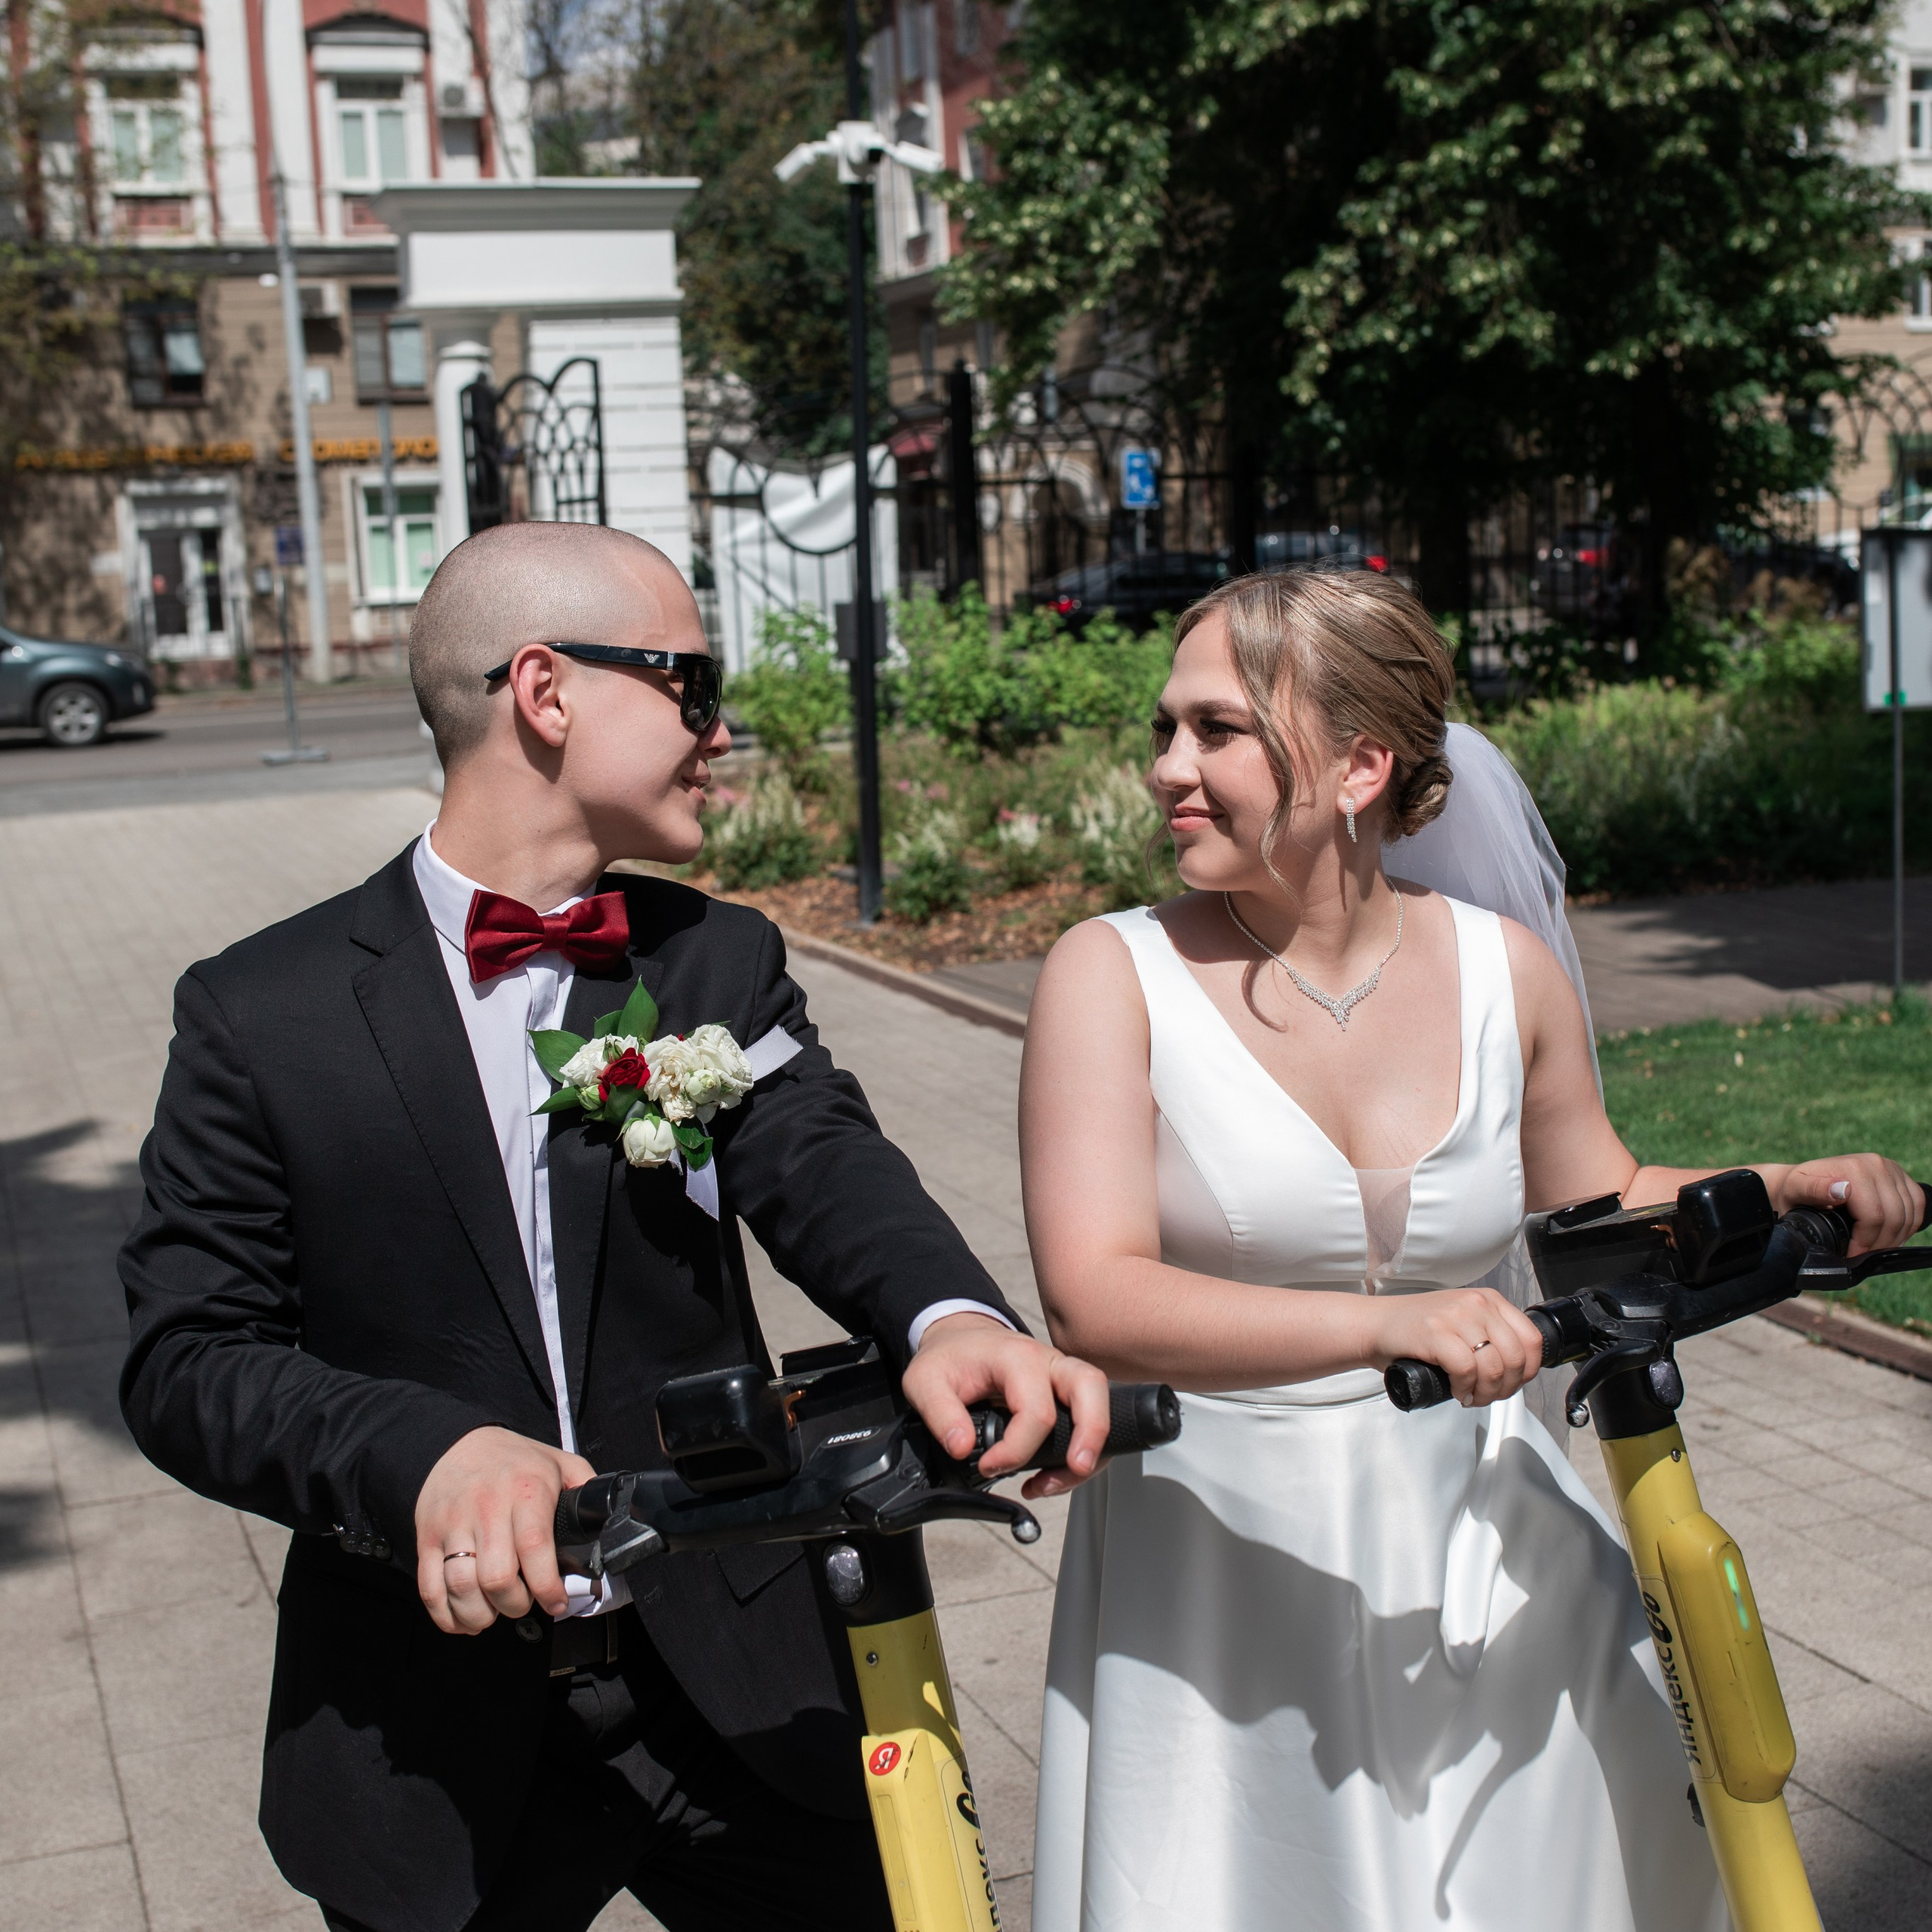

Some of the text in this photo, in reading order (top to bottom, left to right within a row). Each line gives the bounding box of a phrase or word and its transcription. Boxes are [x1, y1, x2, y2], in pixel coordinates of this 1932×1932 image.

[1643, 1591, 1702, 1766] Яндекс Go
[875, 1747, 894, 1770] Я
